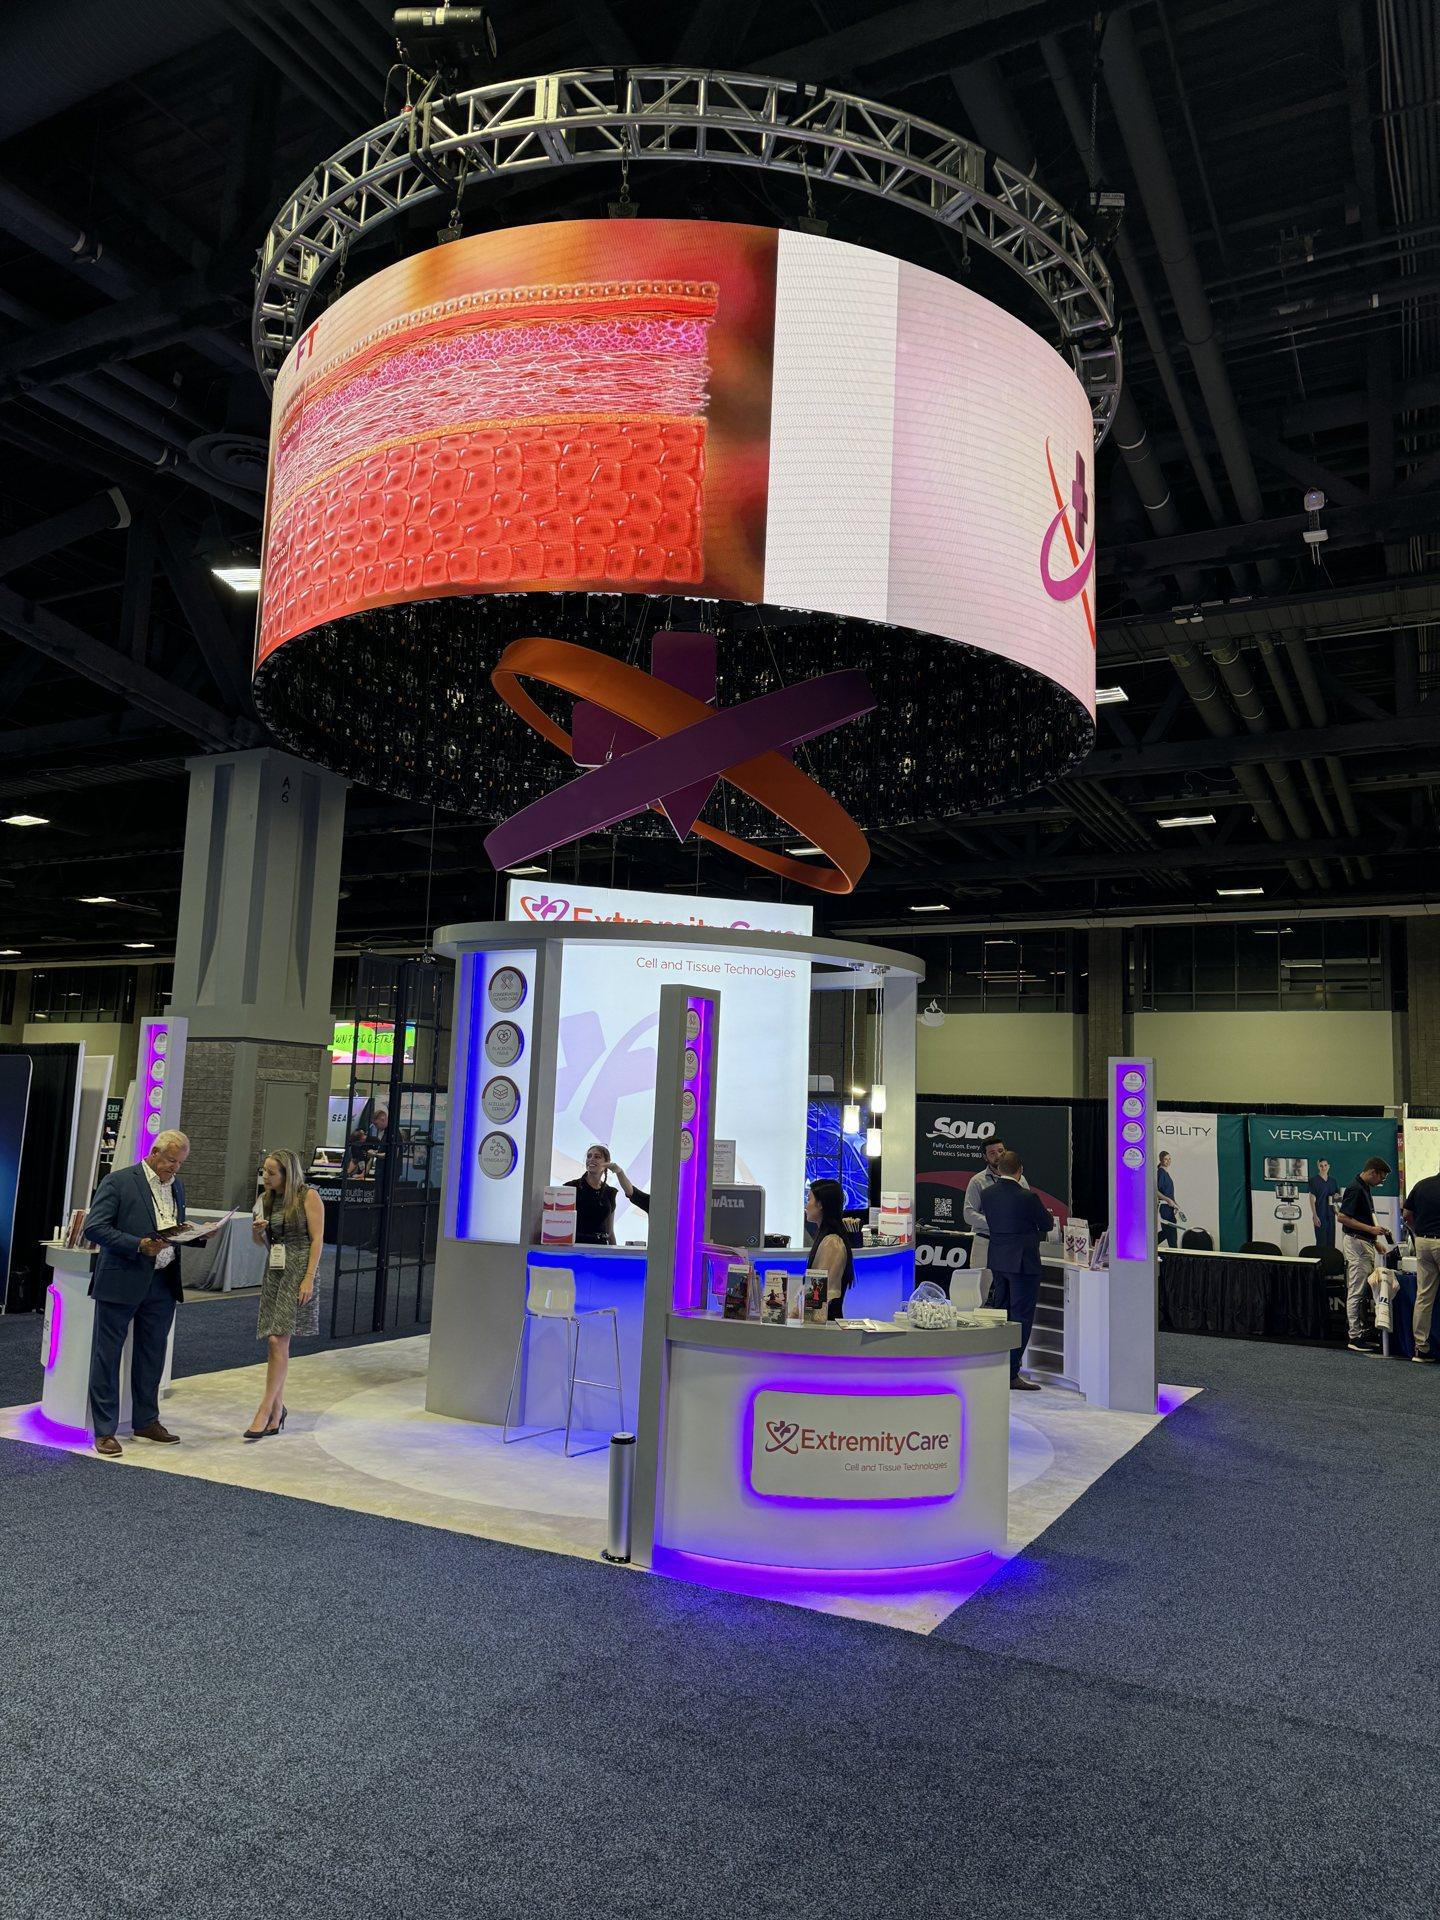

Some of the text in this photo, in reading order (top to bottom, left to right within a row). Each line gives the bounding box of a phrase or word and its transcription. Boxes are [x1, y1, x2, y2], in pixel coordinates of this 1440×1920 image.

[295, 322, 319, 372] FT
[282, 776, 291, 789] A
[281, 791, 289, 803] 6
[636, 957, 797, 979] Cell and Tissue Technologies
[932, 1116, 996, 1139] SOLO
[1268, 1129, 1373, 1142] VERSATILITY
[932, 1142, 945, 1150] Fully
[966, 1143, 981, 1151] Every
[319, 1187, 342, 1196] DOCTO
[712, 1195, 745, 1208] VAZZA
[915, 1244, 967, 1268] OLO
[801, 1428, 949, 1456] ExtremityCare
[844, 1461, 948, 1472] Cell and Tissue Technologies
